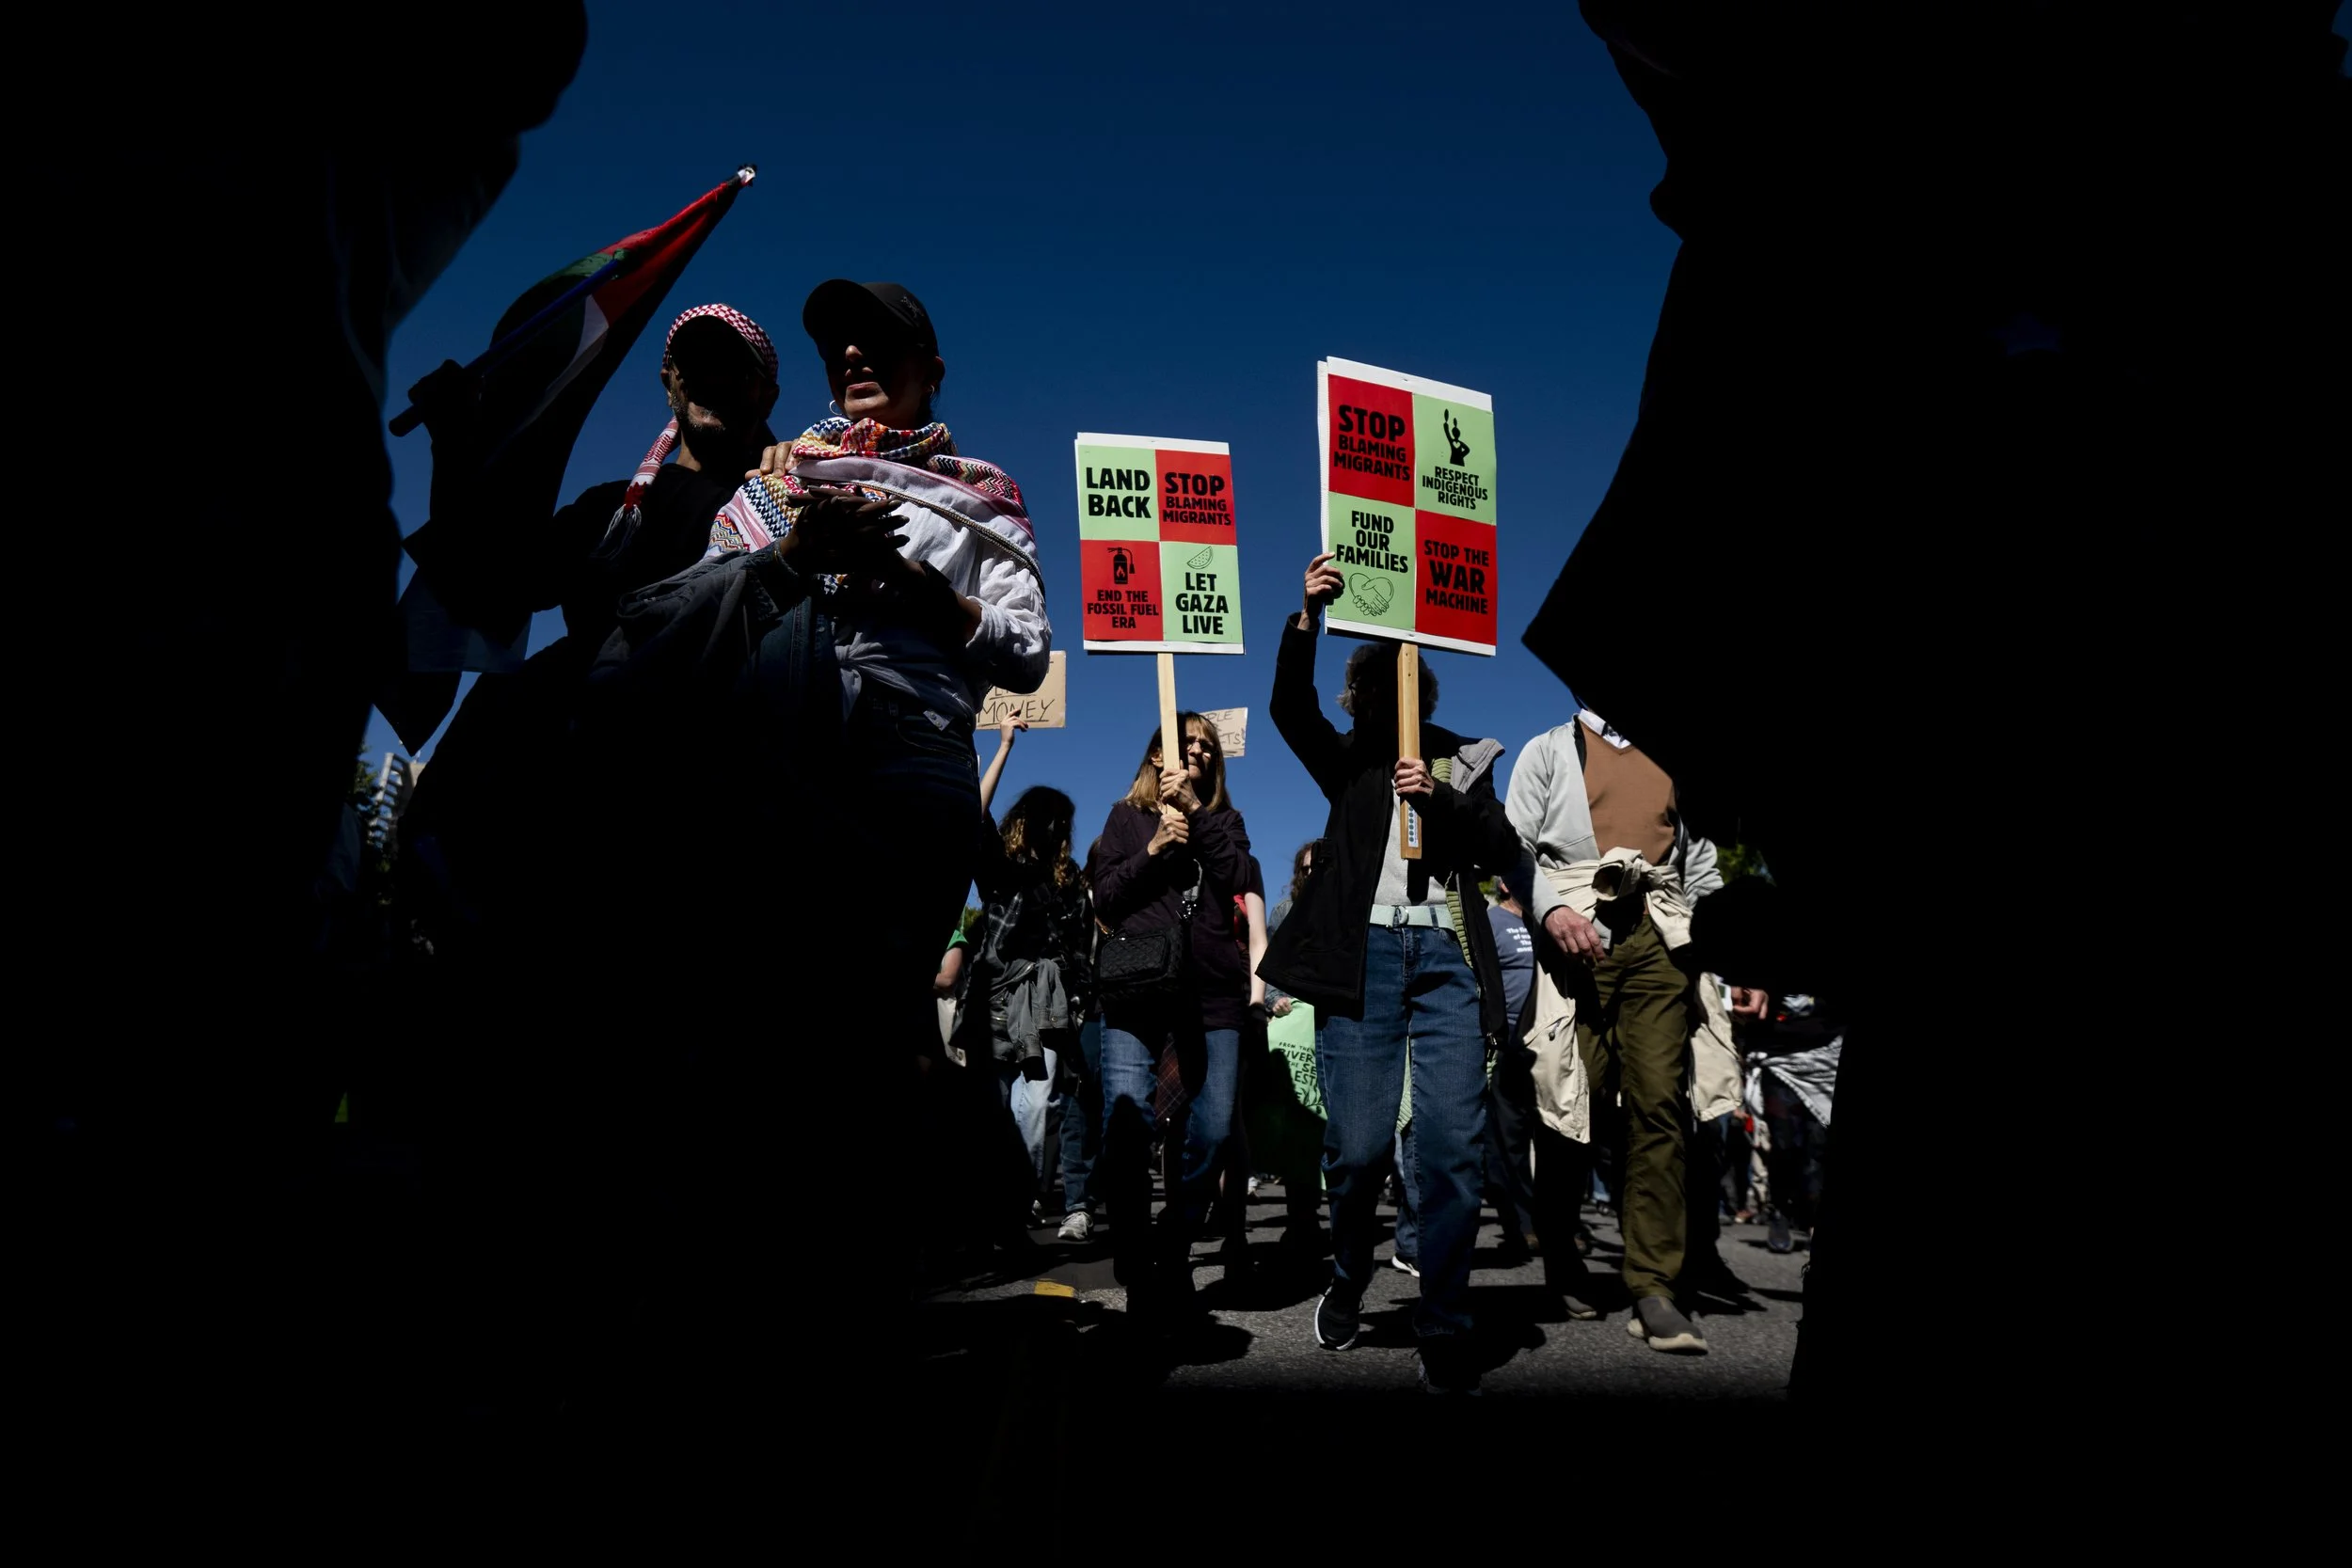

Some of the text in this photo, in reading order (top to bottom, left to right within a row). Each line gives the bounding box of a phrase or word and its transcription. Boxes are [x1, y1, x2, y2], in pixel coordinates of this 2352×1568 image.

[1338, 404, 1406, 442] STOP
[1339, 434, 1406, 464] BLAMING
[1333, 451, 1410, 482] MIGRANTS
[1435, 466, 1480, 486] RESPECT
[1086, 467, 1151, 492] LAND
[1164, 472, 1225, 497] STOP
[1422, 474, 1488, 500] INDIGENOUS
[1088, 494, 1152, 519] BACK
[1166, 496, 1227, 512] BLAMING
[1438, 492, 1476, 511] RIGHTS
[1162, 510, 1232, 526] MIGRANTS
[1351, 510, 1394, 535] FUND
[1355, 530, 1391, 552] OUR
[1423, 539, 1489, 567] STOP THE
[1335, 544, 1408, 574] FAMILIES
[1185, 572, 1217, 592] LET
[1429, 560, 1486, 595] WAR
[1097, 590, 1149, 603] END THE
[1175, 594, 1229, 614] GAZA
[1425, 588, 1488, 615] MACHINE
[1087, 602, 1159, 616] FOSSIL FUEL
[1111, 616, 1136, 629] ERA
[1182, 614, 1224, 635] LIVE
[977, 699, 1055, 723] MONEY
[1205, 711, 1233, 722] PLE
